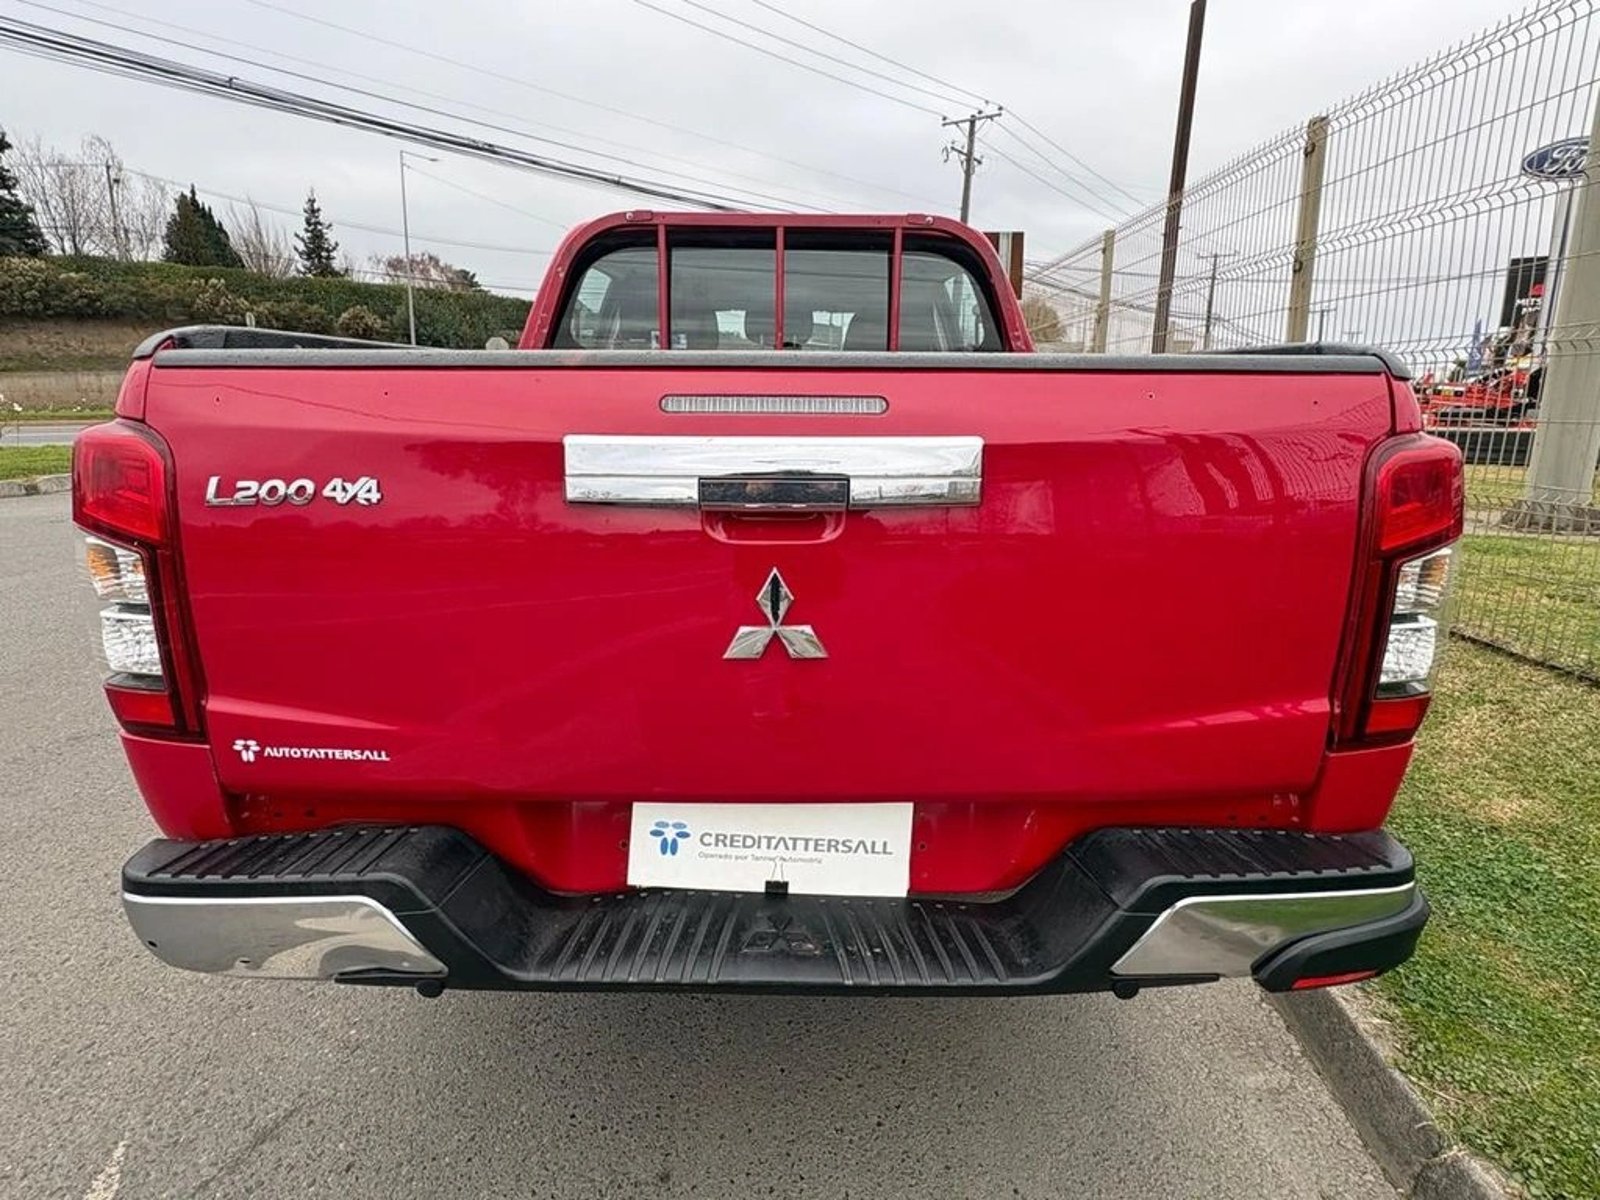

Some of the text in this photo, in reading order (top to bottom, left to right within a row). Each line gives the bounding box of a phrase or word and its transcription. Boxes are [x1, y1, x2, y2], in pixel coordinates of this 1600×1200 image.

[205, 475, 315, 506] L200
[264, 746, 391, 762] AUTOTATTERSALL
[699, 832, 894, 856] CREDITATTERSALL
